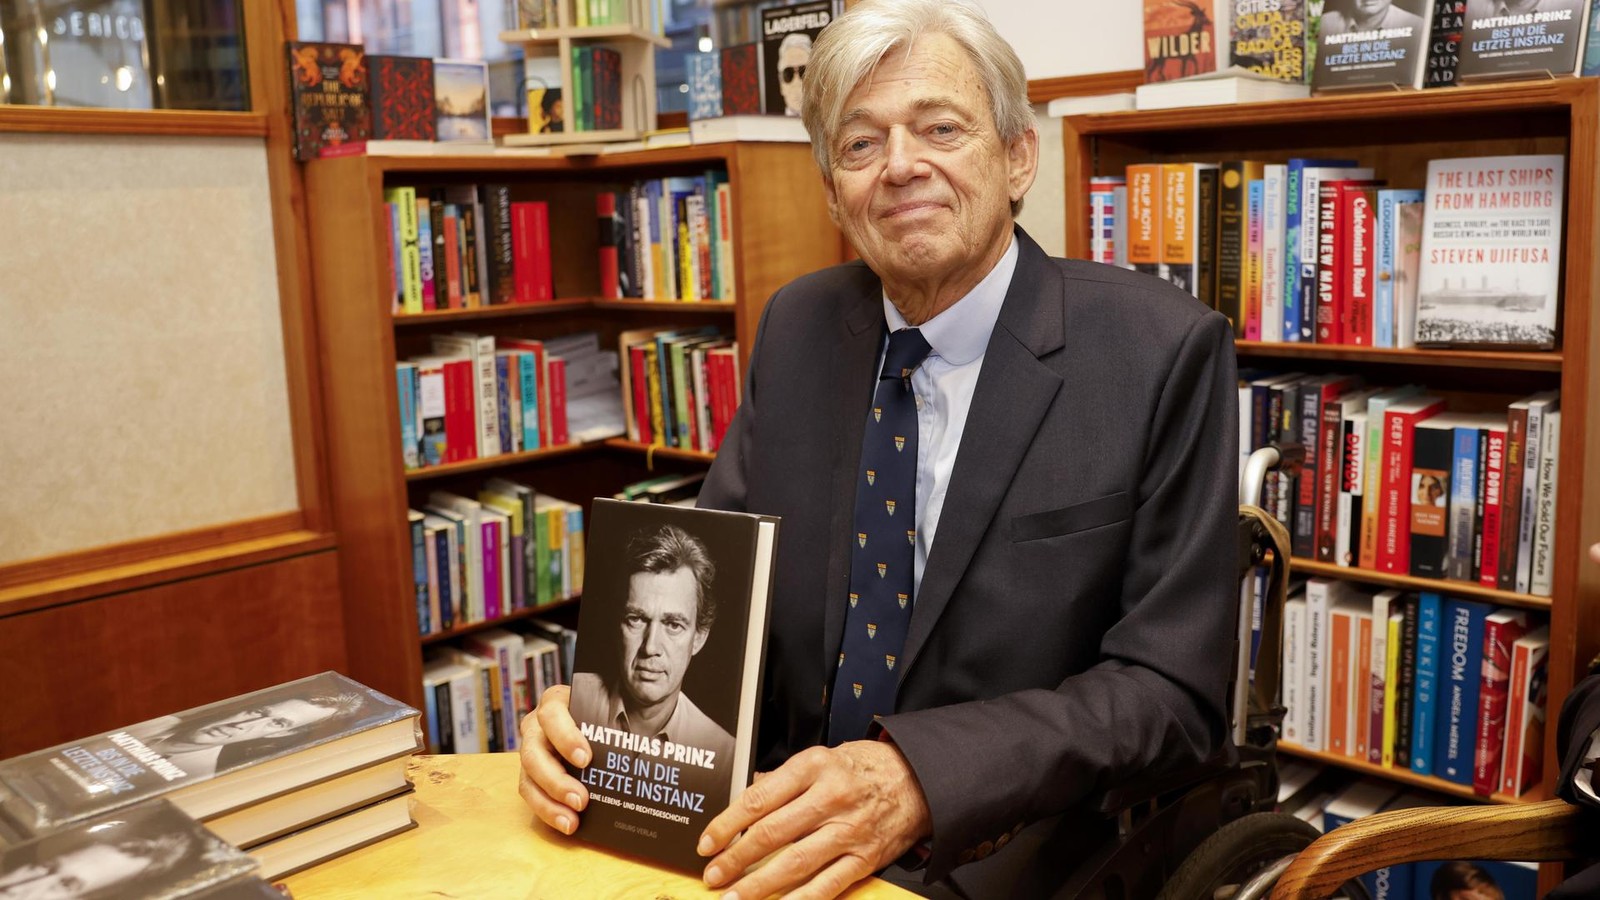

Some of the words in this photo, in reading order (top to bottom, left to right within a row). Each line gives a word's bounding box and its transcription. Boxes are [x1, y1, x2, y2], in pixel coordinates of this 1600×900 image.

[764, 11, 831, 35] LAGERFELD
[1472, 14, 1533, 30] MATTHIAS
[1534, 10, 1572, 23] PRINZ
[1492, 28, 1510, 39] BIS
[1512, 26, 1525, 37] IN
[1527, 25, 1547, 36] DIE
[1147, 31, 1211, 59] WILDER
[1325, 30, 1378, 45] MATTHIAS
[1380, 27, 1412, 39] PRINZ
[1342, 43, 1359, 54] BIS
[1360, 41, 1372, 52] IN
[1373, 40, 1391, 51] DIE
[1472, 38, 1512, 52] LETZTE
[1514, 33, 1564, 47] INSTANZ
[1325, 53, 1360, 65] LETZTE
[1361, 48, 1406, 61] INSTANZ
[1438, 171, 1463, 189] THE
[1468, 170, 1504, 187] LAST
[1509, 168, 1554, 185] SHIPS
[1435, 193, 1474, 210] FROM
[1479, 191, 1553, 208] HAMBURG
[1141, 208, 1151, 241] ROTH
[1175, 208, 1185, 241] ROTH
[1322, 202, 1335, 230] THE
[1353, 197, 1367, 266] Caledonian
[1320, 234, 1334, 266] NEW
[1431, 250, 1485, 264] STEVEN
[1490, 248, 1549, 264] UJIFUSA
[1319, 270, 1333, 302] MAP
[1353, 268, 1366, 298] Road
[1304, 394, 1318, 417] THE
[1302, 418, 1317, 465] CAPITAL
[1392, 416, 1403, 447] DEBT
[1345, 434, 1359, 491] DIVIDE
[1489, 437, 1502, 469] SLOW
[1543, 458, 1553, 481] How
[1487, 471, 1500, 505] DOWN
[1543, 482, 1552, 498] We
[1541, 499, 1551, 522] Sold
[1540, 523, 1550, 542] Our
[1537, 543, 1549, 577] Future
[1451, 607, 1470, 682] FREEDOM
[1452, 685, 1463, 723] ANGELA
[581, 722, 661, 757] MATTHIAS
[663, 741, 716, 769] PRINZ
[1448, 724, 1459, 760] MERKEL
[151, 758, 187, 781] PRINZ
[606, 751, 630, 773] BIS
[633, 759, 650, 778] IN
[654, 763, 680, 785] DIE
[581, 767, 633, 795] LETZTE
[636, 780, 705, 813] INSTANZ
[589, 792, 602, 801] EINE
[602, 795, 622, 808] LEBENS-
[623, 801, 635, 811] UND
[635, 804, 690, 825] RECHTSGESCHICHTE
[636, 827, 658, 839] VERLAG
